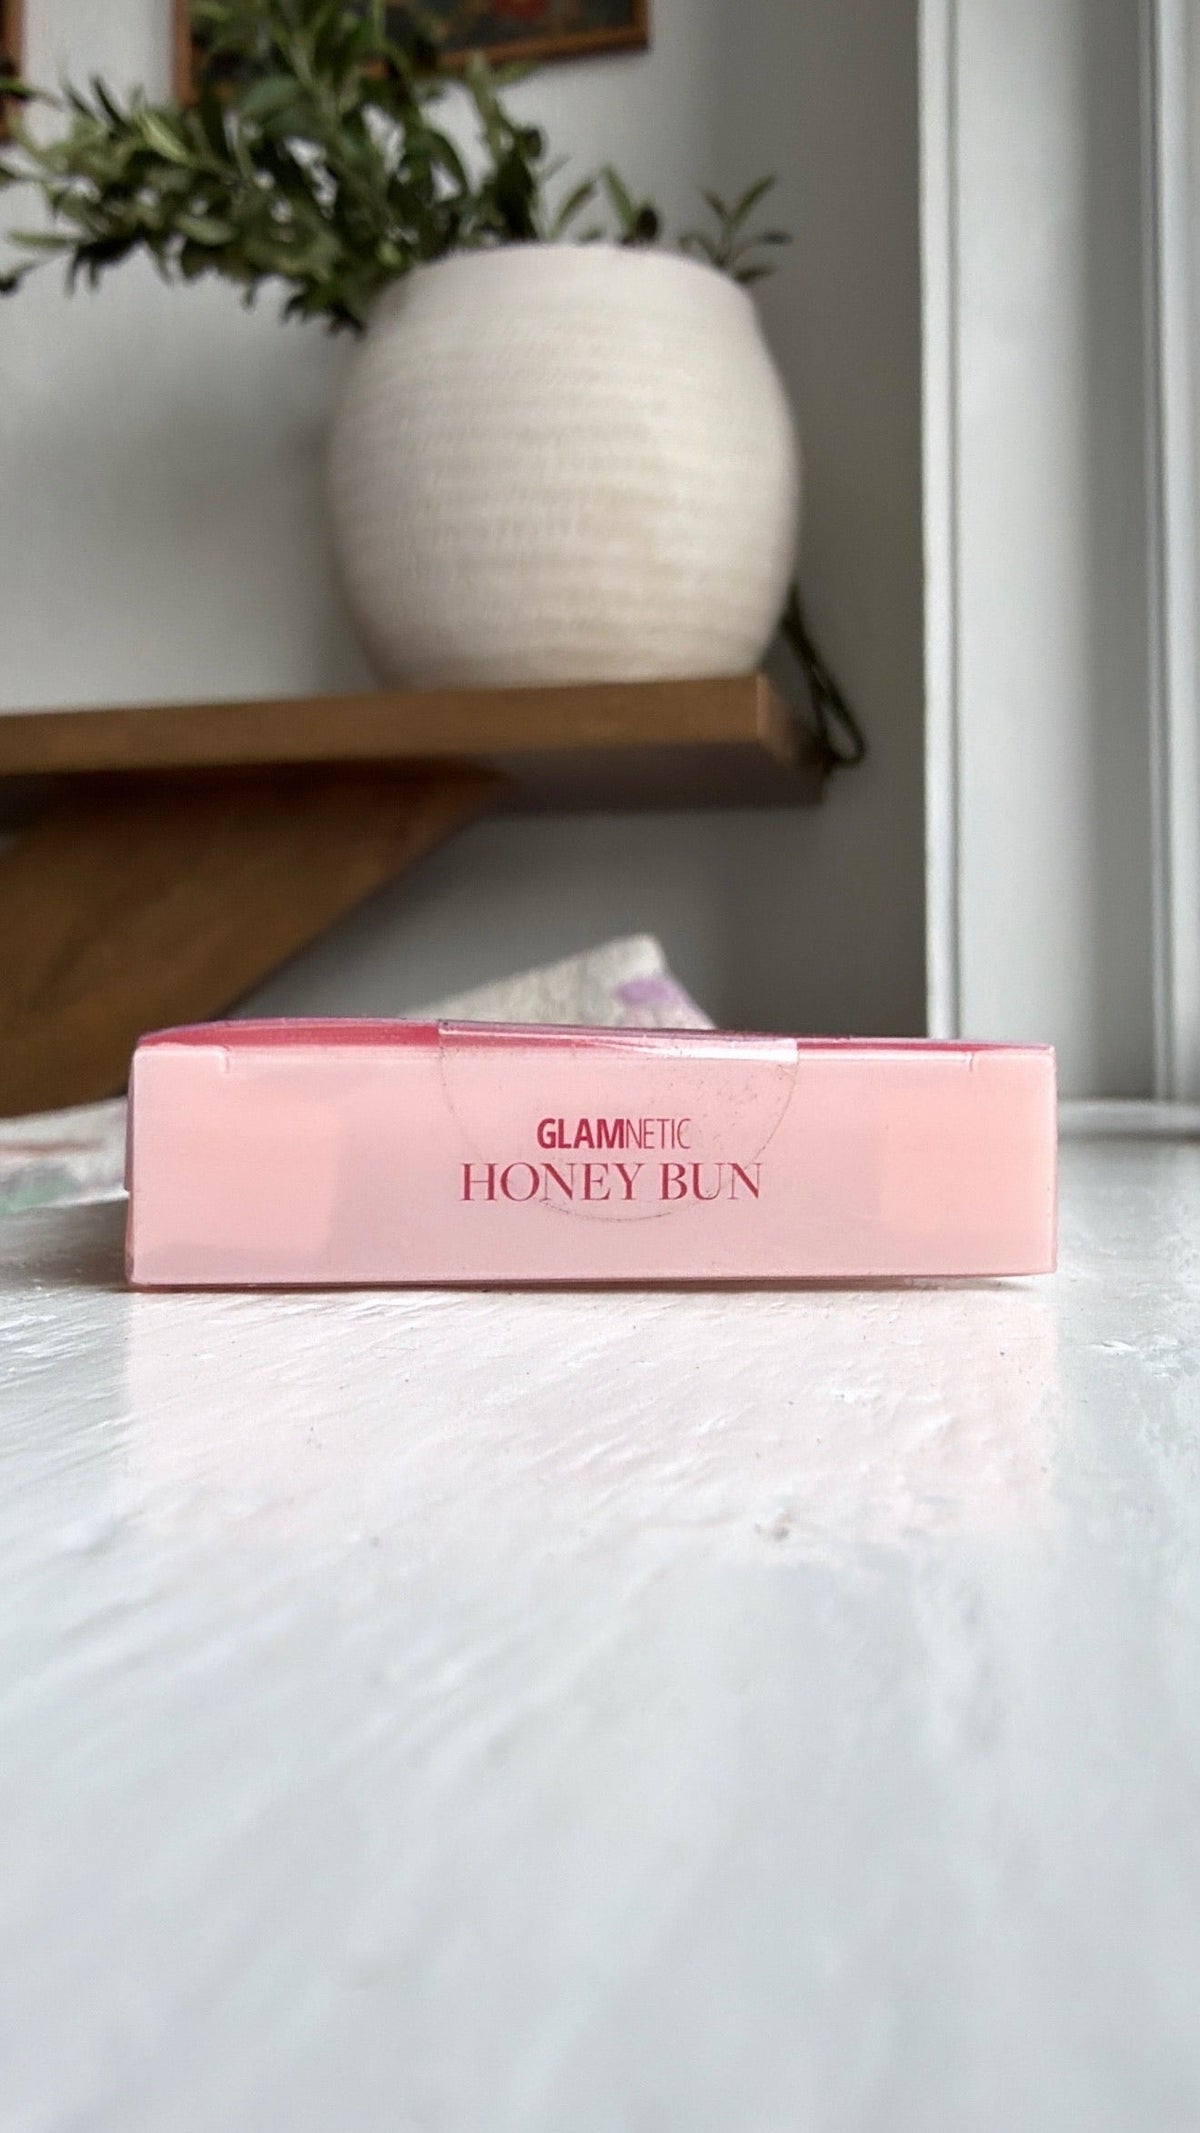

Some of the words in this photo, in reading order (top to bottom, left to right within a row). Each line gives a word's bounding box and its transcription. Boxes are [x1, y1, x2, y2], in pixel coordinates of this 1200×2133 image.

[536, 1117, 692, 1150] GLAMNETIC
[460, 1162, 645, 1202] HONEY
[660, 1162, 763, 1201] BUN
